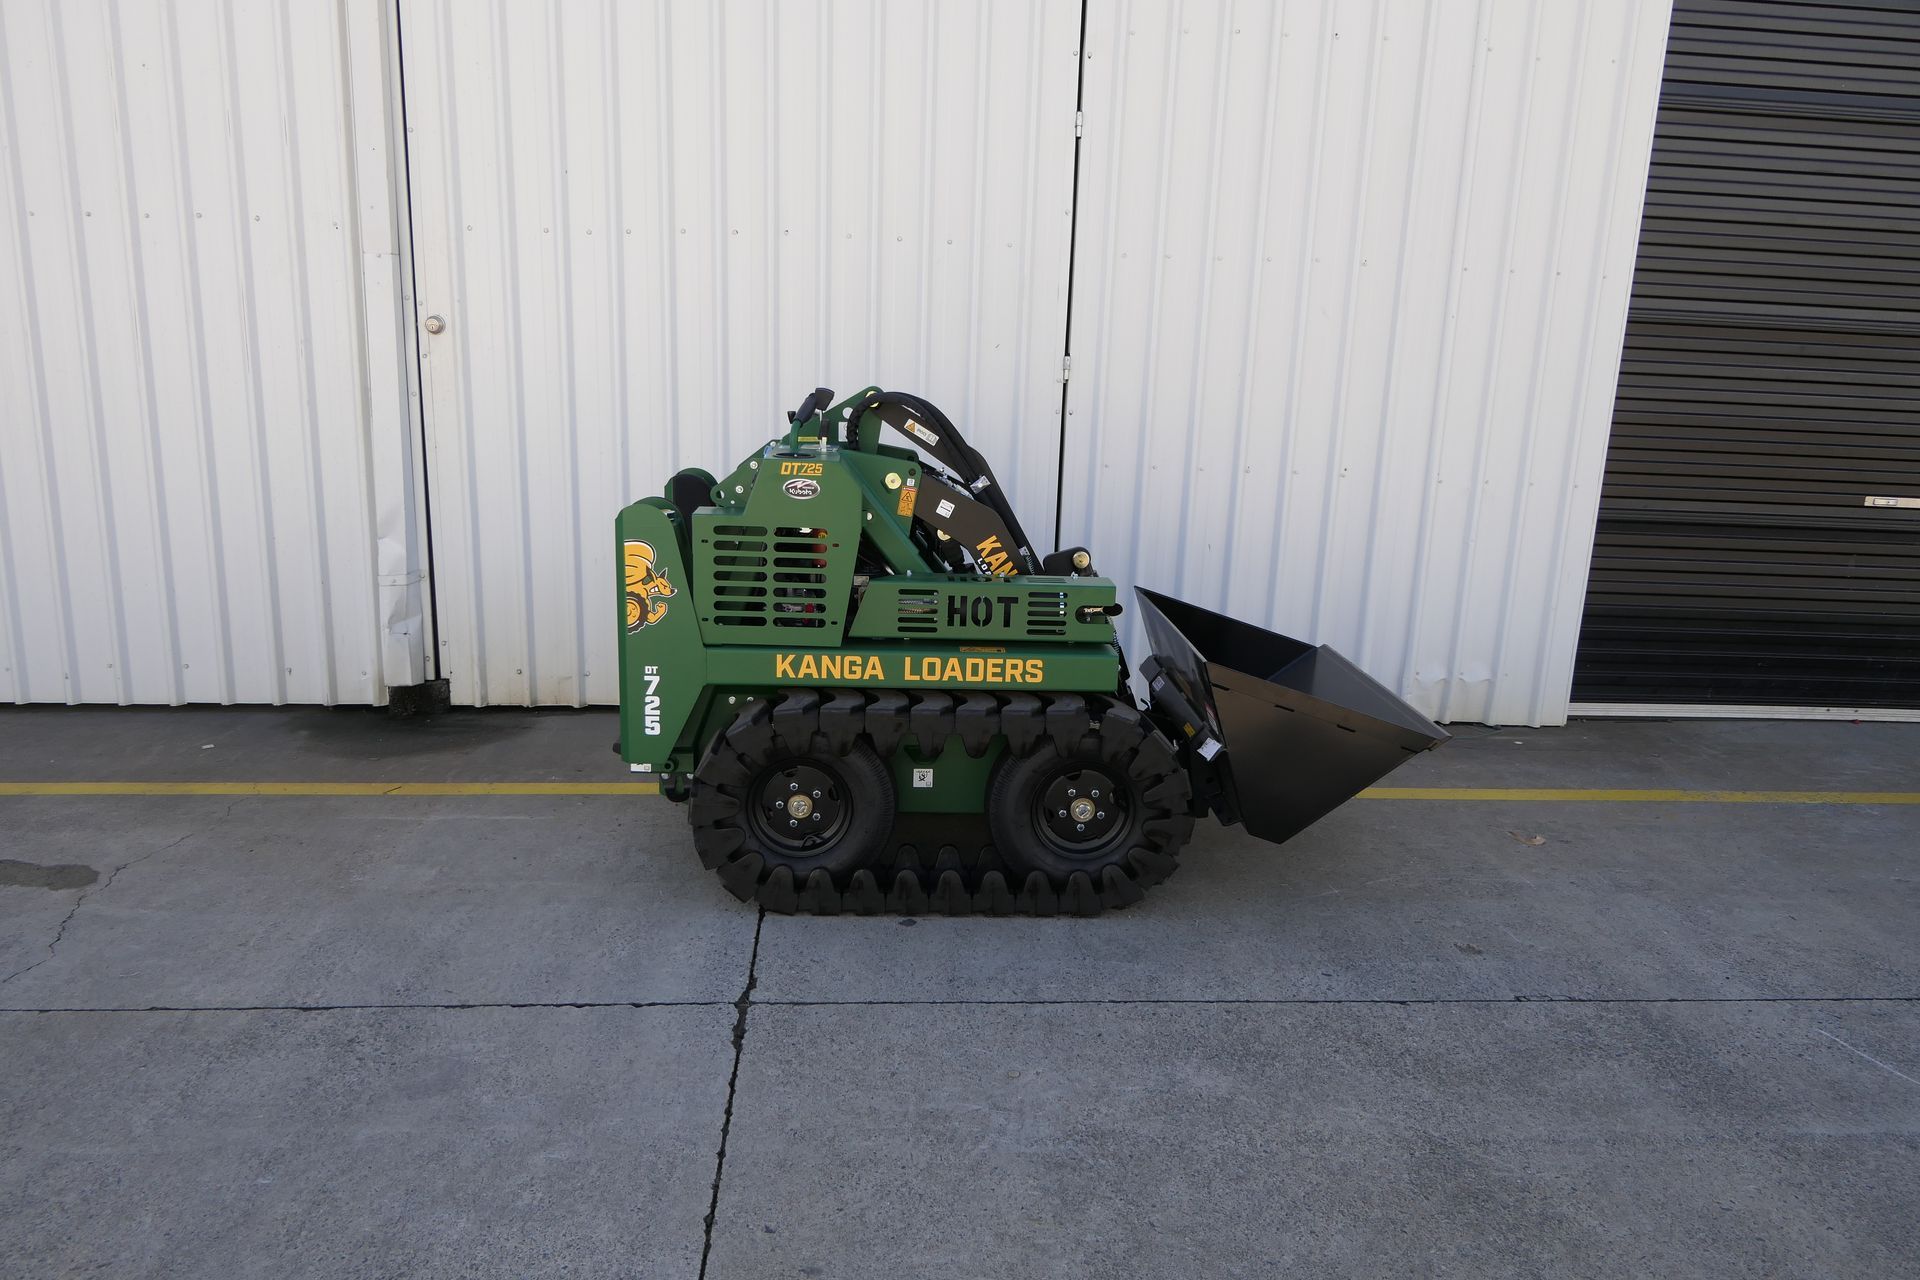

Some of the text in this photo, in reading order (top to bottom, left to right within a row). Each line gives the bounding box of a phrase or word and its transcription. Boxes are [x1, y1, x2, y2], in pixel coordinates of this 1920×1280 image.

[780, 461, 823, 476] DT725
[947, 595, 1019, 628] HOT
[644, 665, 659, 674] DT
[776, 654, 1044, 683] KANGA LOADERS
[643, 675, 661, 736] 725
